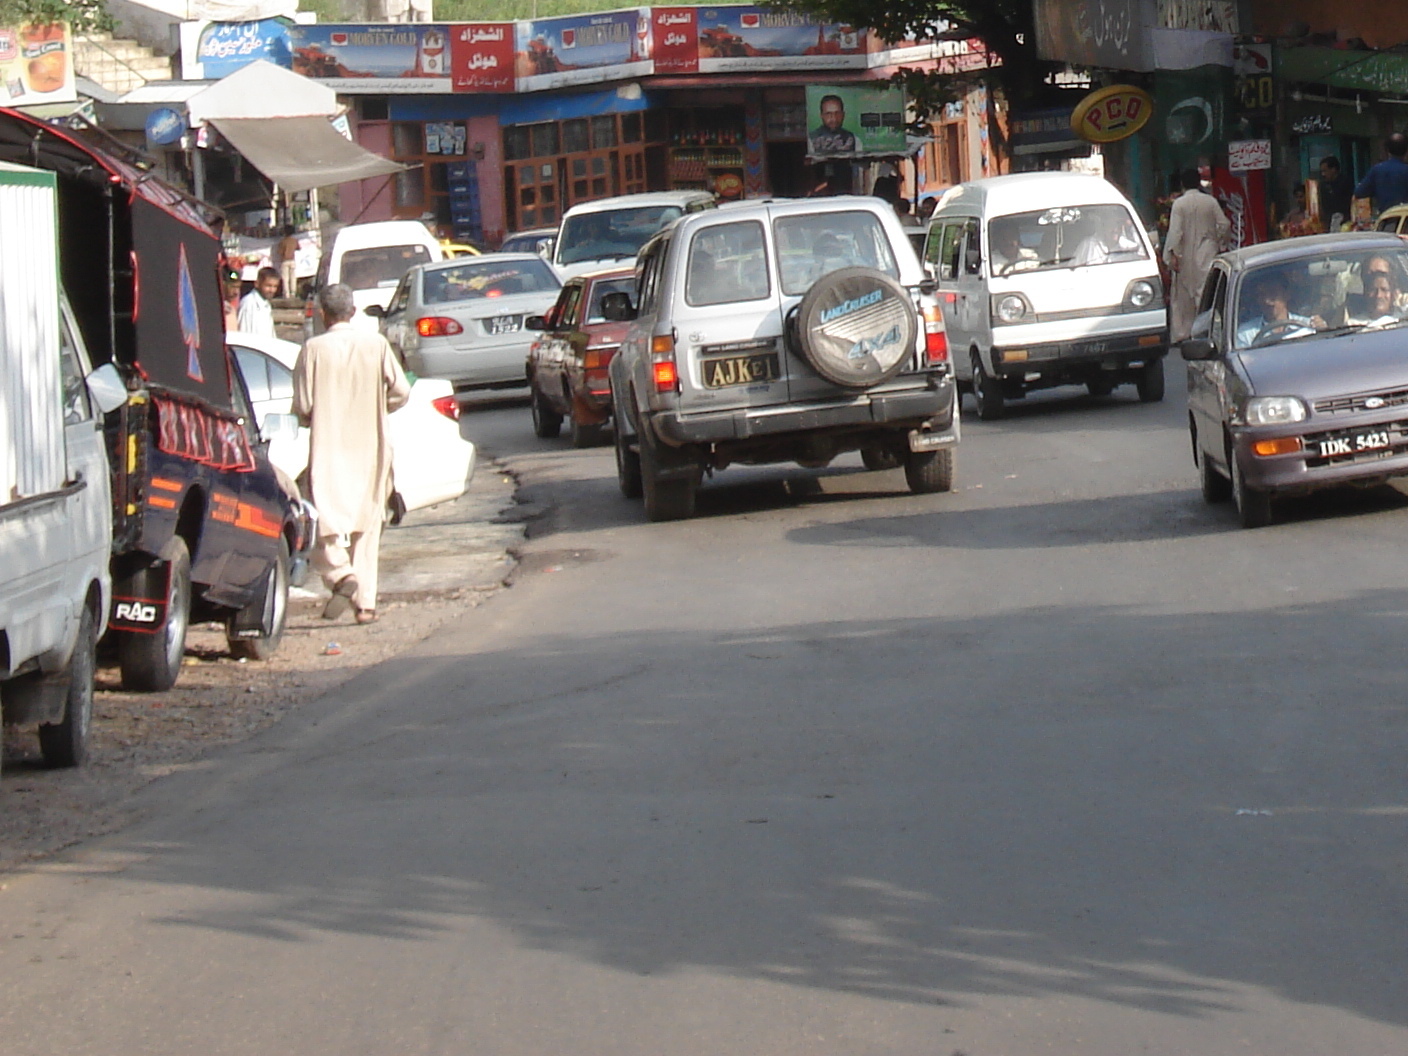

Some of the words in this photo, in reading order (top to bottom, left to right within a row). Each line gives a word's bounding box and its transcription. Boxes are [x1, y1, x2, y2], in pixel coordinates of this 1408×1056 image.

[390, 30, 416, 45] GOLD
[1086, 97, 1143, 132] PCO
[1357, 431, 1389, 450] 5423
